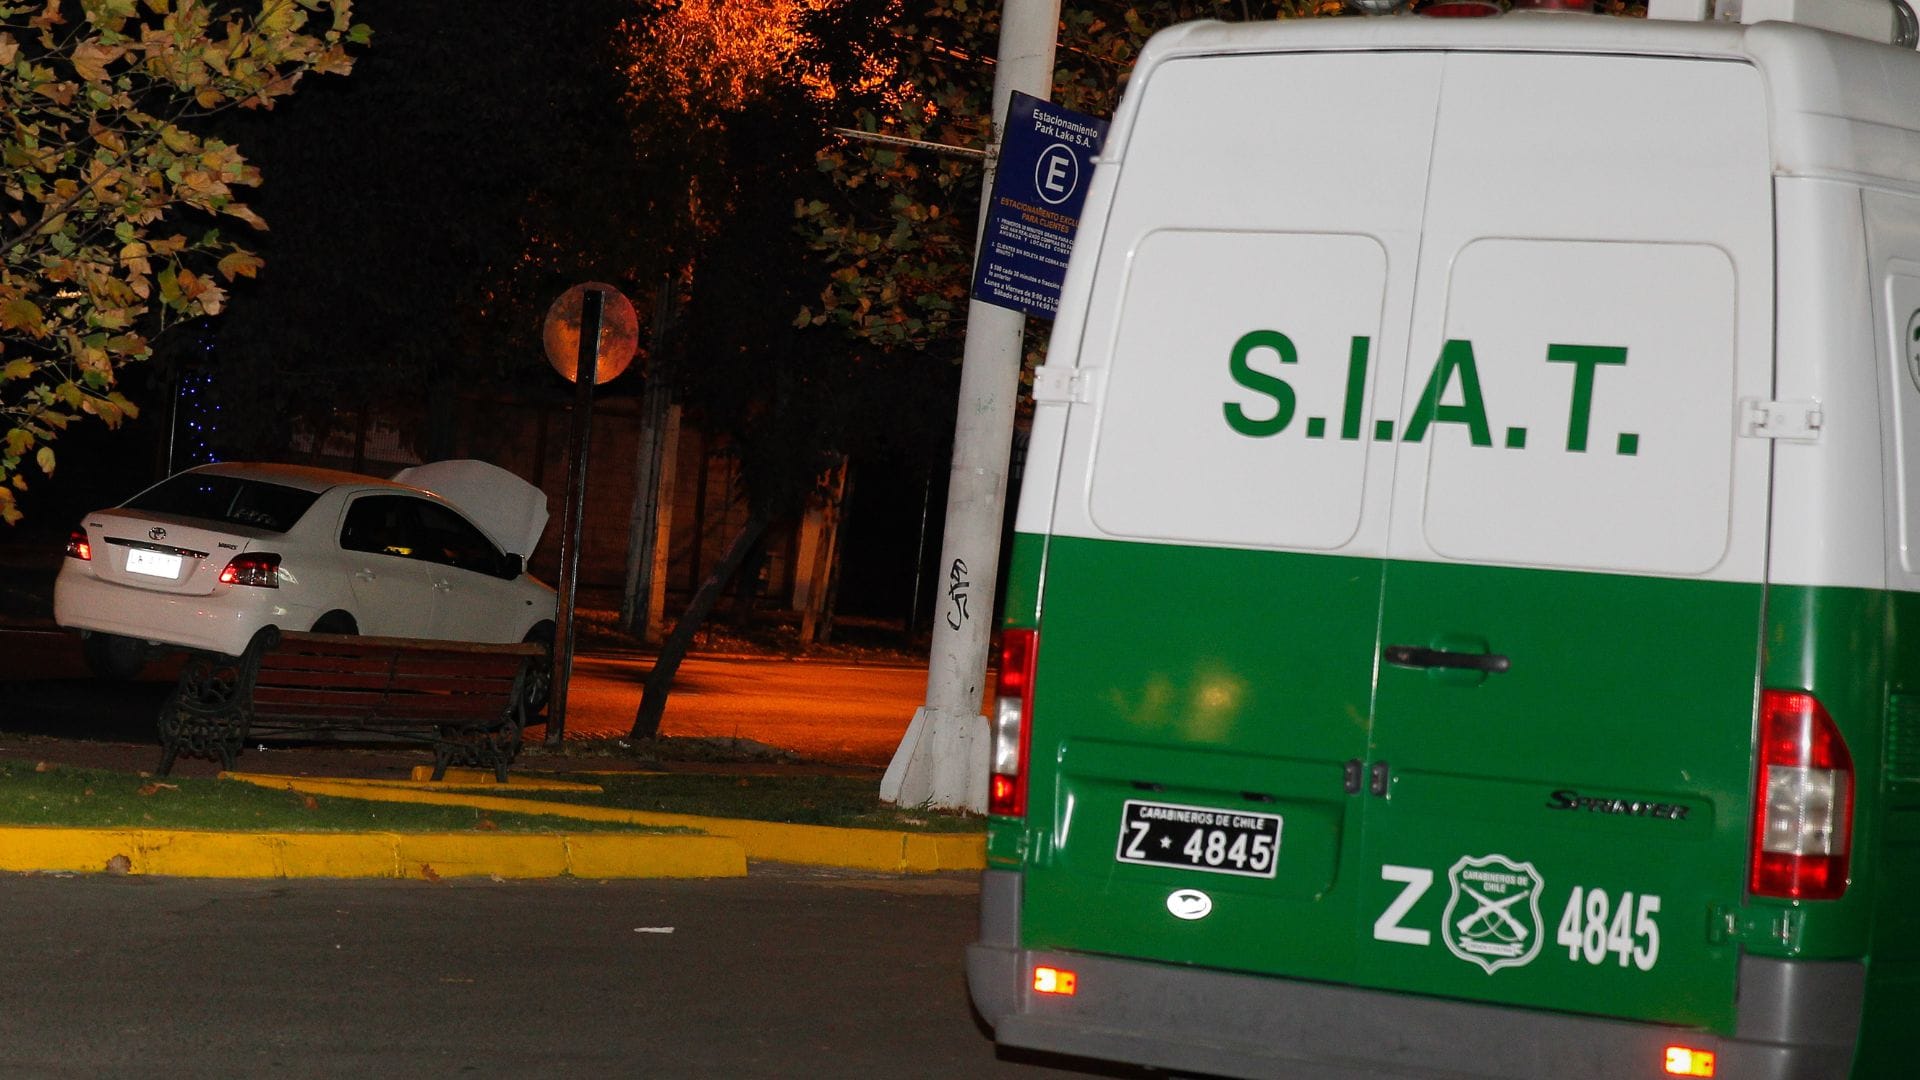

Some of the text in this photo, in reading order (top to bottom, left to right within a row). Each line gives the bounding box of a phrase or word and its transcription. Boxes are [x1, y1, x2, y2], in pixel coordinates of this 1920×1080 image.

[1032, 108, 1098, 138] Estacionamiento
[1034, 122, 1090, 148] Park Lake S.A.
[1046, 156, 1069, 192] E
[1000, 198, 1059, 220] ESTACIONAMIENTO
[1022, 213, 1070, 233] PARA CLIENTES
[984, 278, 1000, 289] Lunes
[1005, 283, 1024, 295] Viernes
[1223, 330, 1638, 456] S.I.A.T.
[1139, 807, 1264, 830] CARABINEROS DE CHILE
[1126, 821, 1272, 871] Z 4845
[1462, 870, 1528, 886] CARABINEROS DE
[1483, 882, 1506, 893] CHILE
[1374, 864, 1434, 946] Z
[1556, 886, 1661, 972] 4845
